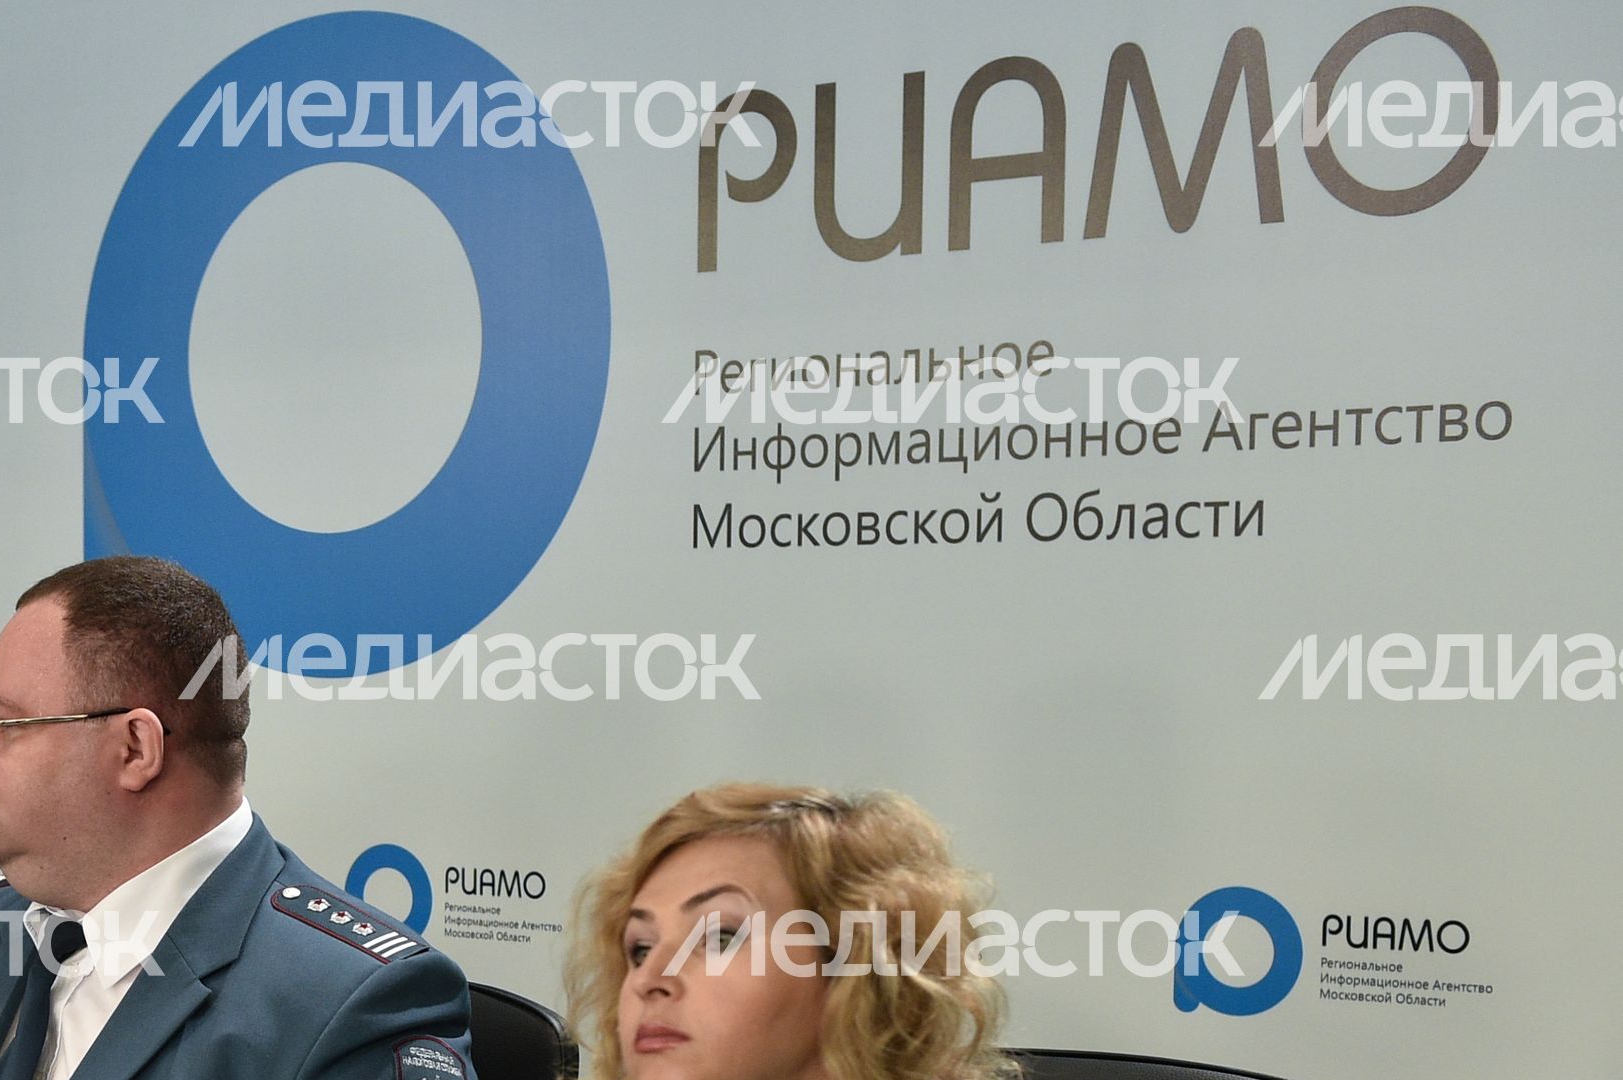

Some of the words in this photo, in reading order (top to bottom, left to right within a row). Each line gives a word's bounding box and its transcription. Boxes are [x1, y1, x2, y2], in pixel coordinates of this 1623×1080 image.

[696, 5, 1501, 273] РИАМО
[693, 337, 1056, 396] Региональное
[692, 410, 1183, 484] Информационное
[1203, 400, 1514, 453] Агентство
[691, 492, 1005, 549] Московской
[1025, 490, 1266, 544] Области
[444, 866, 546, 899] РИАМО
[444, 902, 501, 915] Региональное
[444, 915, 519, 930] Информационное
[521, 920, 563, 932] Агентство
[444, 928, 494, 940] Московской
[496, 931, 531, 943] Области
[1322, 914, 1470, 954] РИАМО
[1321, 957, 1403, 973] Региональное
[1320, 973, 1429, 990] Информационное
[1432, 980, 1493, 994] Агентство
[1319, 988, 1392, 1004] Московской
[1395, 992, 1446, 1007] Области
